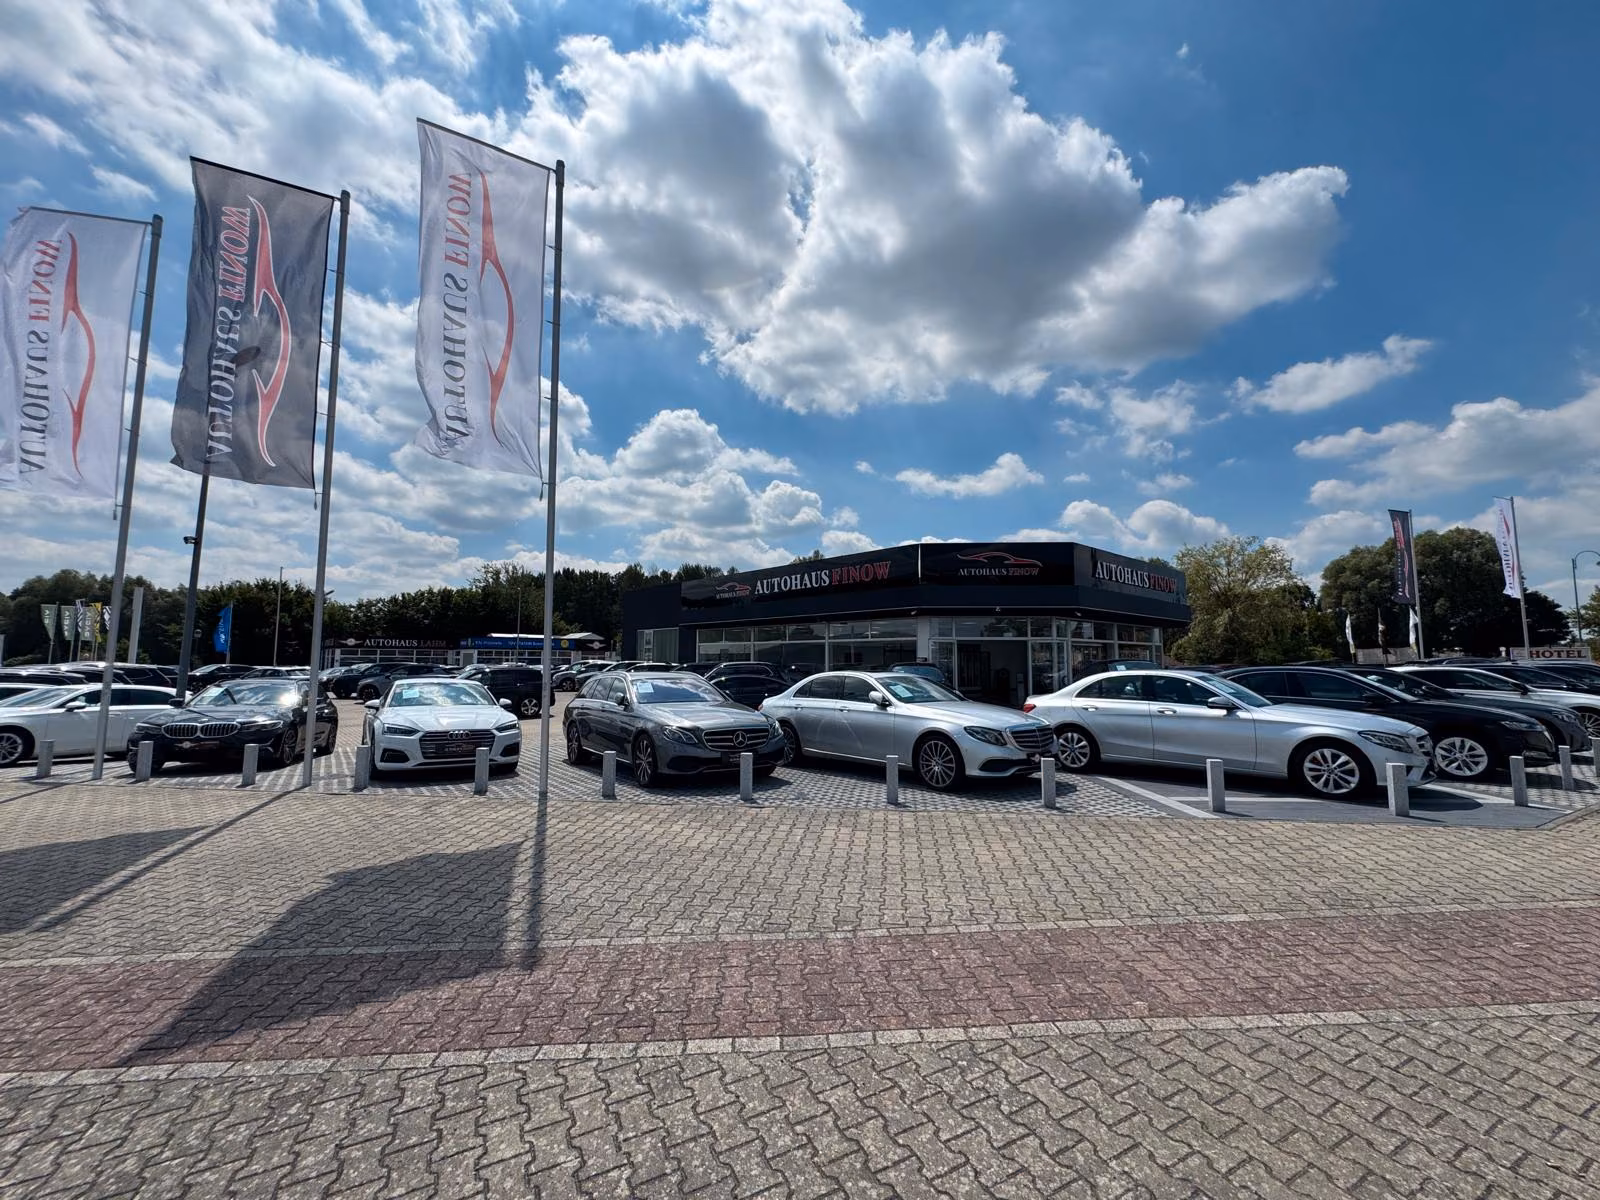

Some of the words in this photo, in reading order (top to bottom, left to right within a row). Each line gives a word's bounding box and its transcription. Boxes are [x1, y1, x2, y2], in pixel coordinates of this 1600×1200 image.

[959, 567, 1007, 576] AUTOHAUS
[1008, 567, 1040, 576] FINOW
[754, 569, 829, 595] AUTOHAUS
[831, 561, 891, 585] FINOW
[1095, 560, 1150, 588] AUTOHAUS
[1150, 573, 1177, 593] FINOW
[363, 638, 418, 647] AUTOHAUS
[1529, 649, 1587, 658] HOTEL
